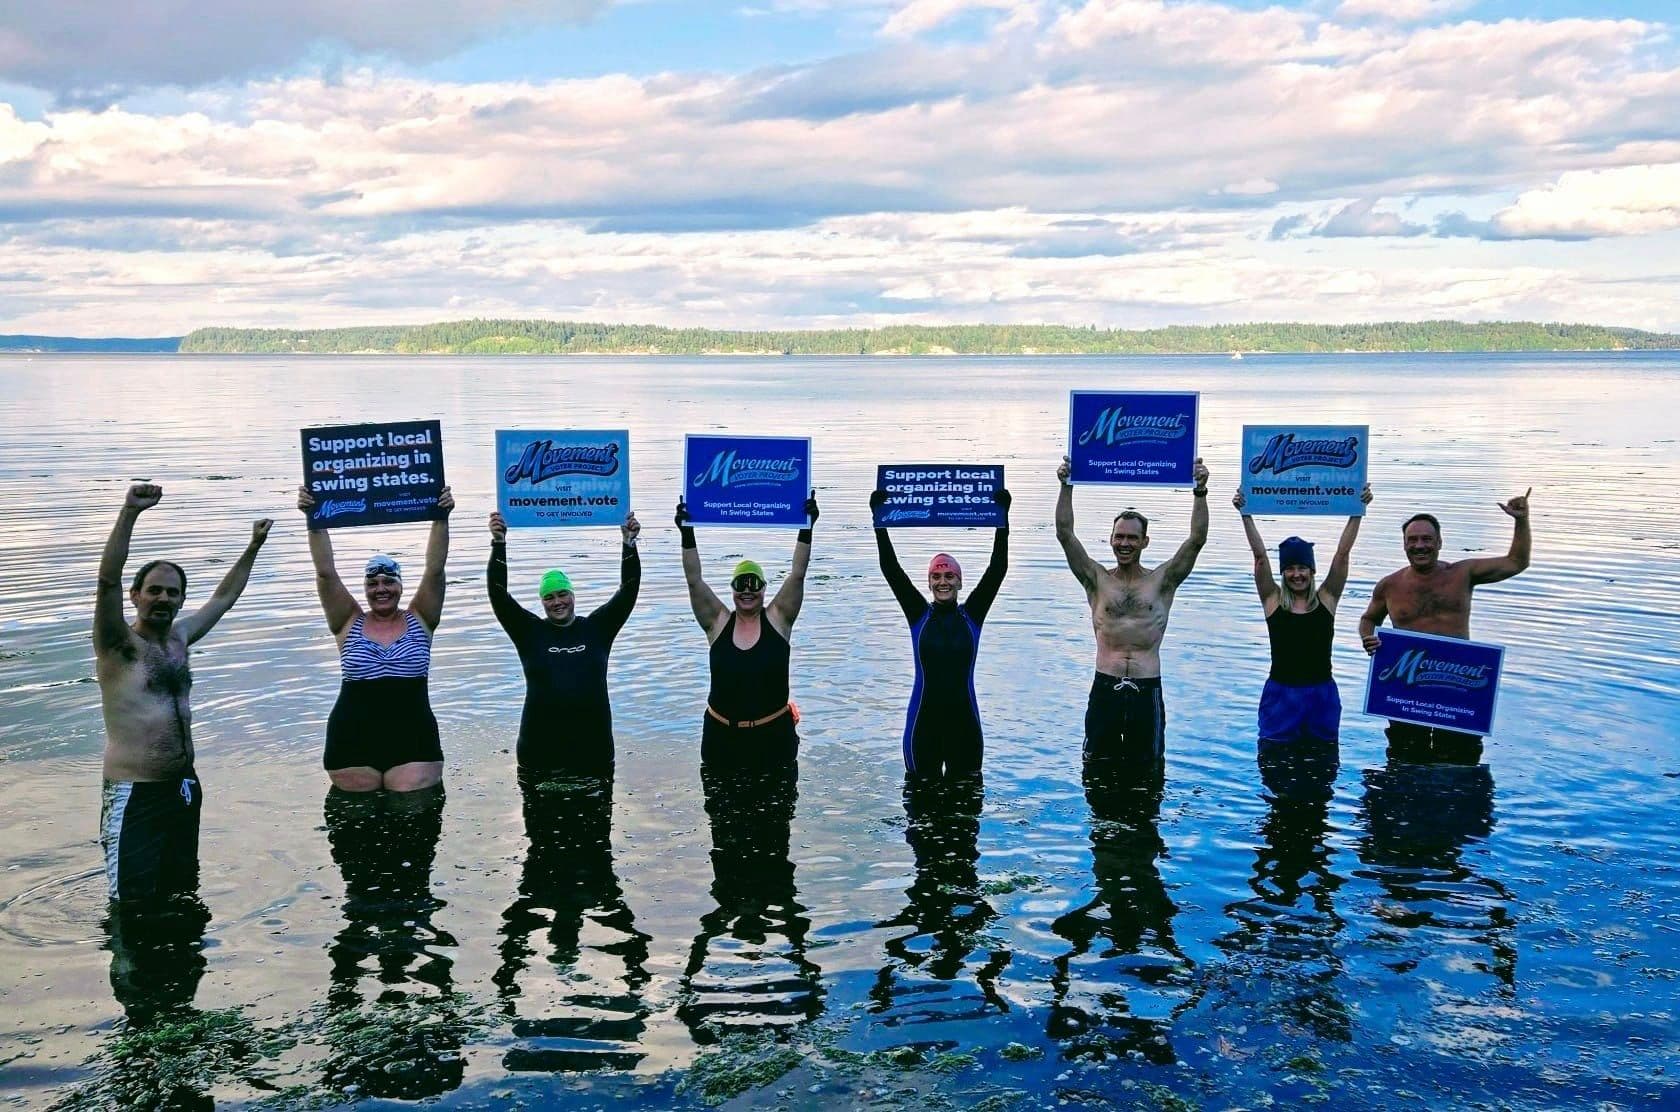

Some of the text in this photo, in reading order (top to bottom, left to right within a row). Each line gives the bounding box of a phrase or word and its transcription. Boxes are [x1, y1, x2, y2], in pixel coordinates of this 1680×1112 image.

[1079, 406, 1190, 446] Movement
[309, 429, 432, 454] Support local
[1248, 433, 1359, 475] Movement
[312, 450, 431, 474] organizing in
[505, 440, 619, 485] Movement
[1138, 460, 1177, 468] Organizing
[693, 450, 802, 488] Movement
[884, 469, 996, 481] Support local
[1113, 468, 1136, 476] Swing
[312, 472, 435, 492] swing states.
[886, 482, 993, 494] organizing in
[1252, 486, 1355, 496] movement.vote
[373, 496, 438, 509] movement.vote
[509, 495, 619, 507] movement.vote
[704, 501, 732, 509] Support
[753, 502, 791, 510] Organizing
[883, 494, 996, 506] swing states.
[313, 498, 367, 520] Movement
[729, 509, 751, 517] Swing
[1378, 649, 1493, 685] Movement
[1386, 695, 1475, 716] Support Local Organizing
[1410, 707, 1432, 717] Swing
[1434, 710, 1456, 720] States
